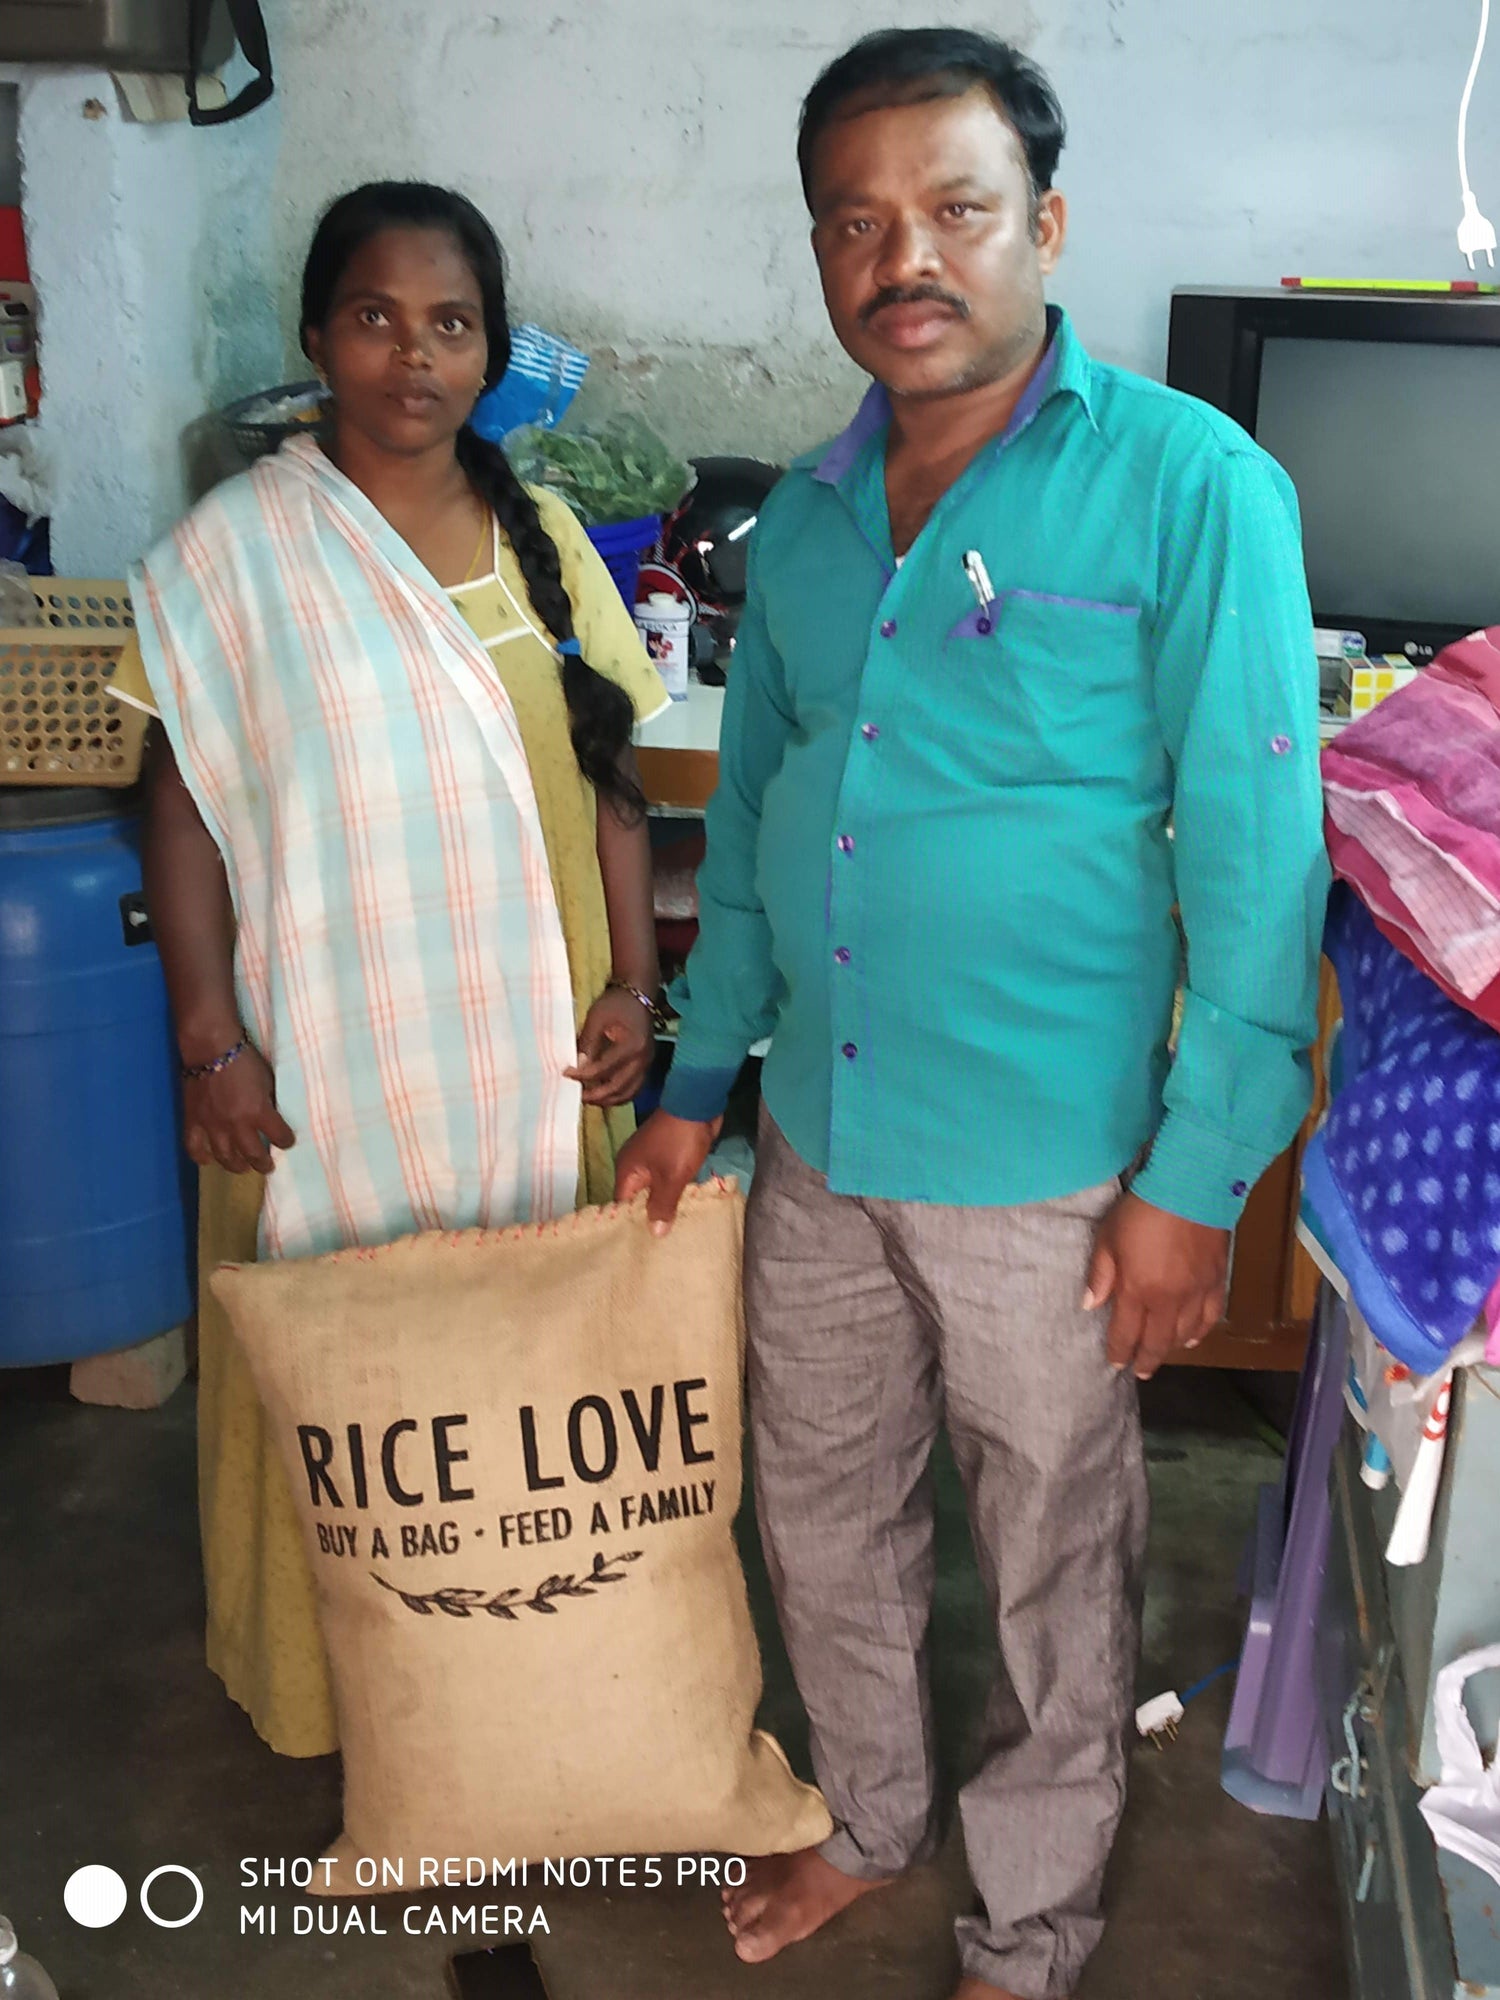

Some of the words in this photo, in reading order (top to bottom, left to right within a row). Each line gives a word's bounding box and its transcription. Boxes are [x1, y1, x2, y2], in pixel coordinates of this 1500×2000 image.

[1418, 645, 1434, 657] LG
[296, 1414, 474, 1509] RICE
[520, 1378, 715, 1492] LOVE
[316, 1521, 358, 1558] BUY
[371, 1527, 390, 1559] A
[400, 1521, 461, 1558] BAG
[500, 1507, 572, 1548] FEED
[590, 1502, 610, 1535] A
[620, 1480, 716, 1530] FAMILY
